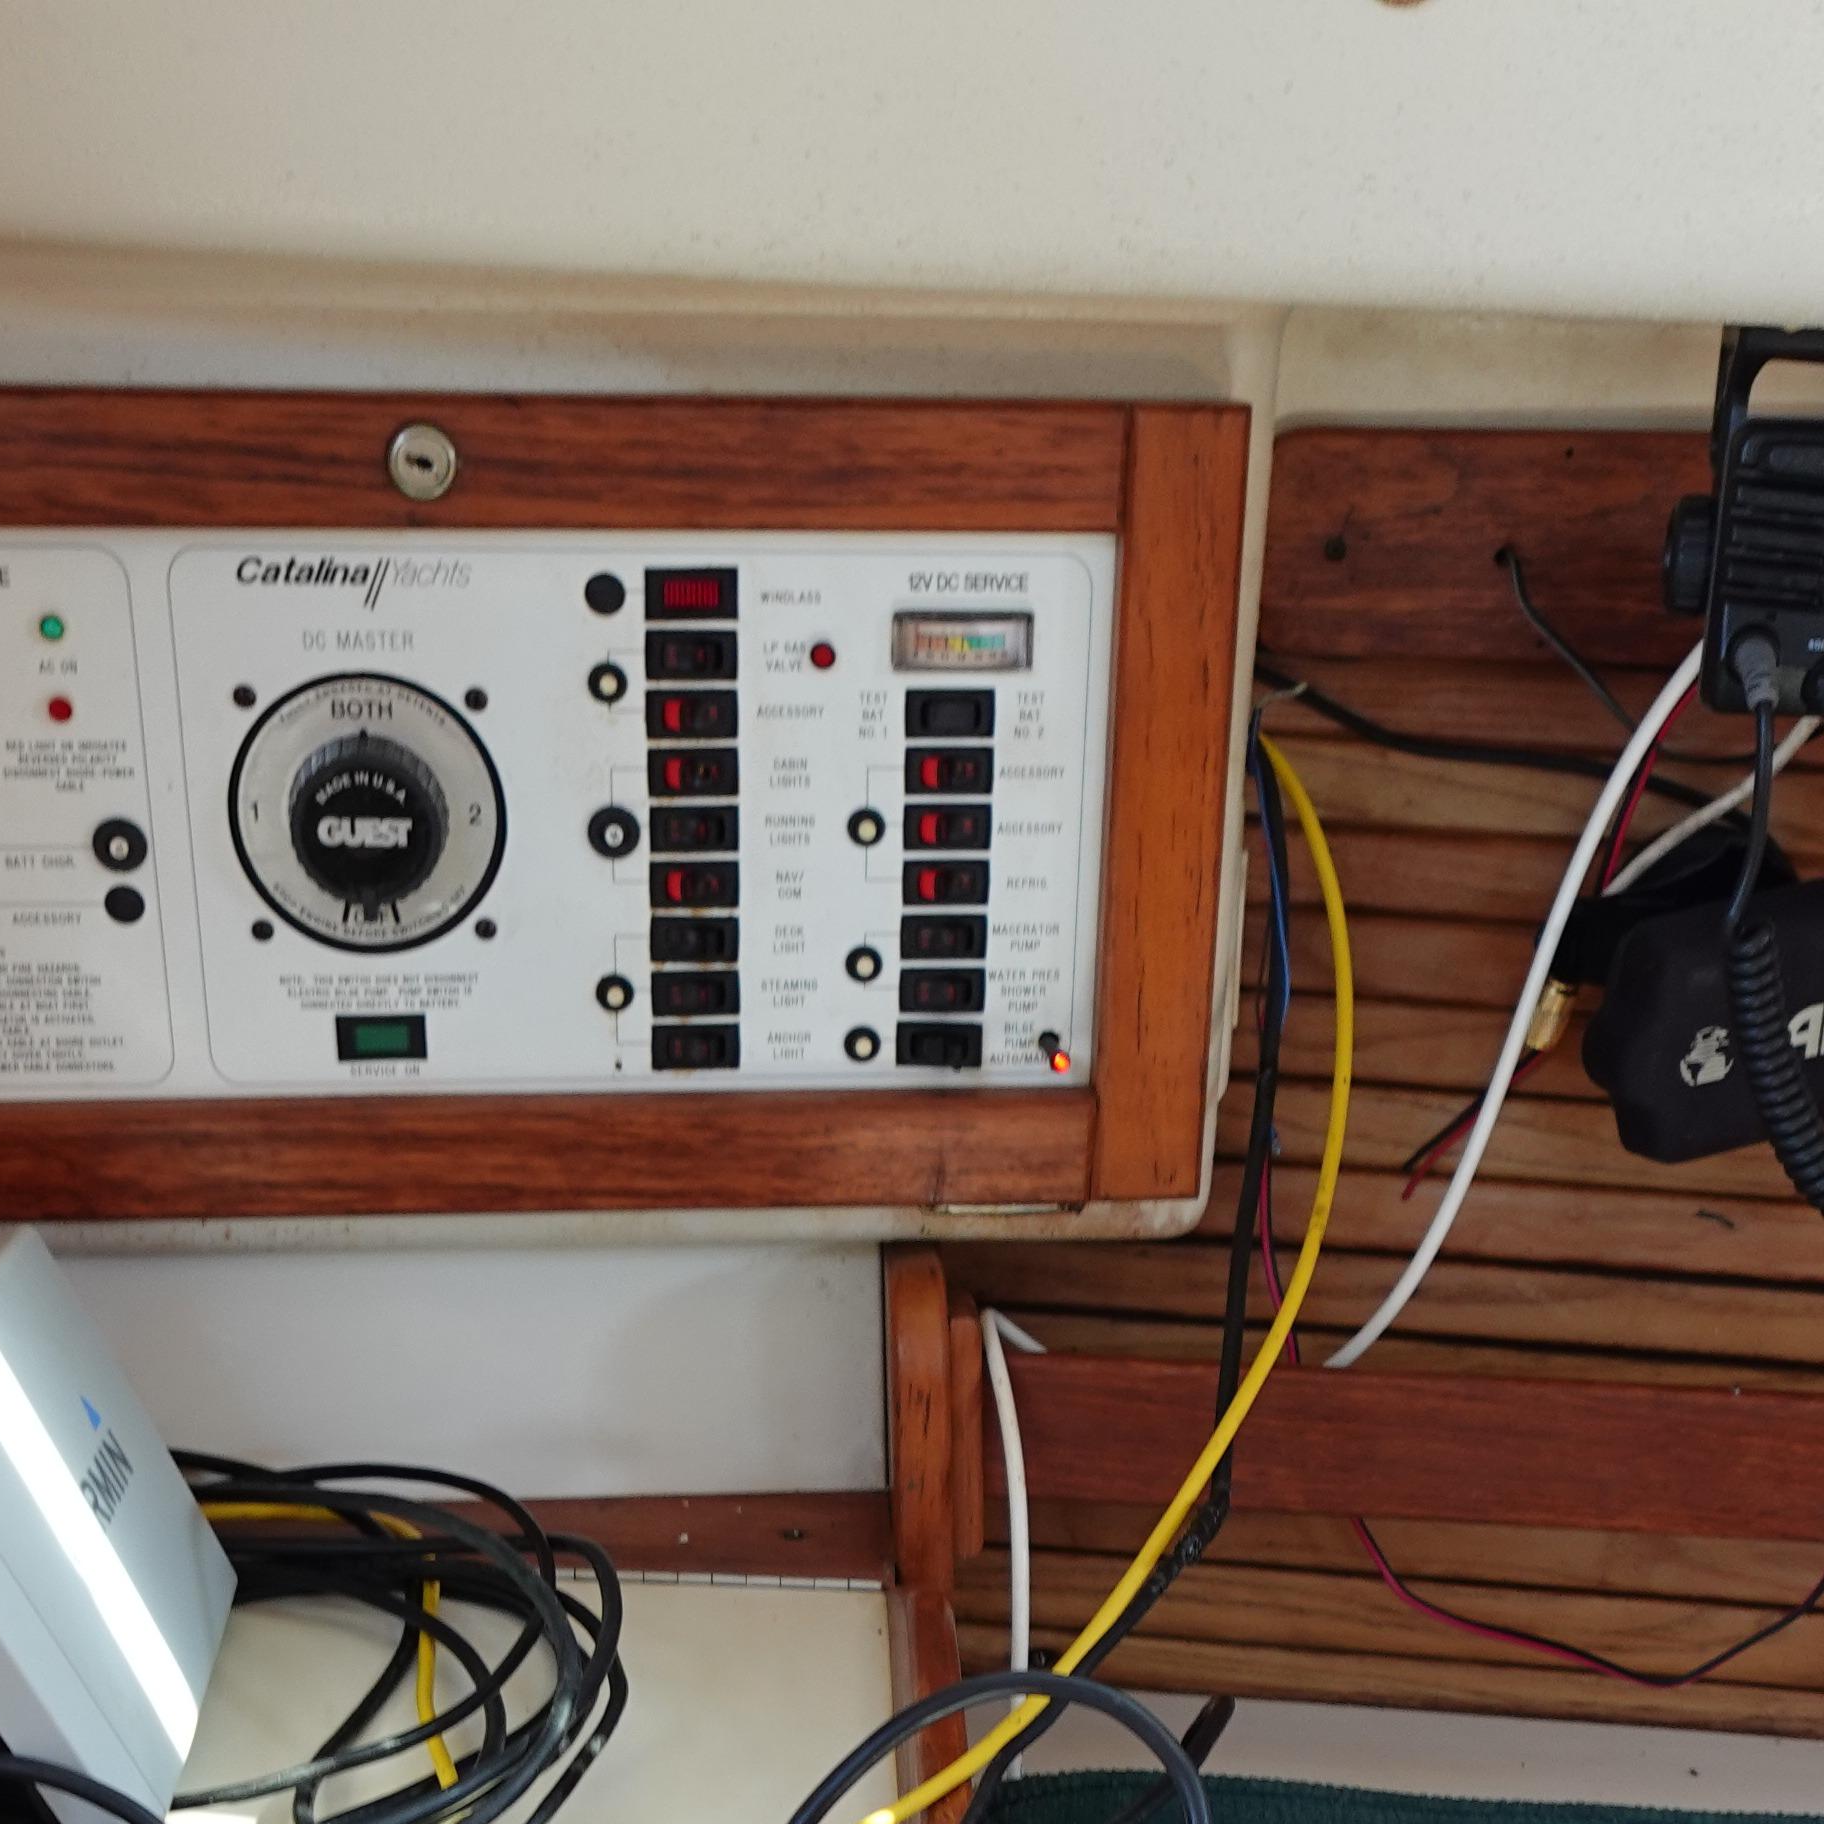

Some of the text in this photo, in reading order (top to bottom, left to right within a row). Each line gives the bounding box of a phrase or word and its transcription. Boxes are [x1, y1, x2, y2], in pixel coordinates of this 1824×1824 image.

[237, 555, 474, 590] Catalina Yachts
[908, 570, 1029, 593] 12V DC SERVICE
[759, 590, 822, 605] WINDLASS
[302, 629, 415, 651] DC MASTER
[766, 659, 804, 672] VALVE
[859, 691, 888, 705] TEST
[1017, 692, 1045, 705] TEST
[330, 700, 394, 721] BOTH
[756, 705, 825, 719] ACCESSORY
[862, 709, 884, 722] BAT
[1019, 709, 1041, 722] BAT
[773, 757, 808, 770] CABIN
[999, 766, 1066, 780] ACCESSORY
[769, 774, 811, 789] LIGHTS
[252, 801, 259, 823] 1
[468, 803, 483, 826] 2
[764, 814, 816, 827] RUNNING
[317, 815, 413, 849] GUEST
[997, 823, 1064, 836] ACCESSORY
[769, 832, 811, 846] LIGHTS
[777, 887, 802, 900] COM
[991, 923, 1061, 936] MACERATOR
[773, 942, 806, 955] LIGHT
[1010, 940, 1042, 952] PUMP
[988, 969, 1026, 982] WATER
[761, 977, 818, 991] STEAMING
[1000, 985, 1047, 997] SHOWER
[773, 996, 806, 1009] LIGHT
[1008, 1000, 1039, 1012] PUMP
[1004, 1037, 1035, 1050] PUMP
[79, 1428, 134, 1526] RMIN
